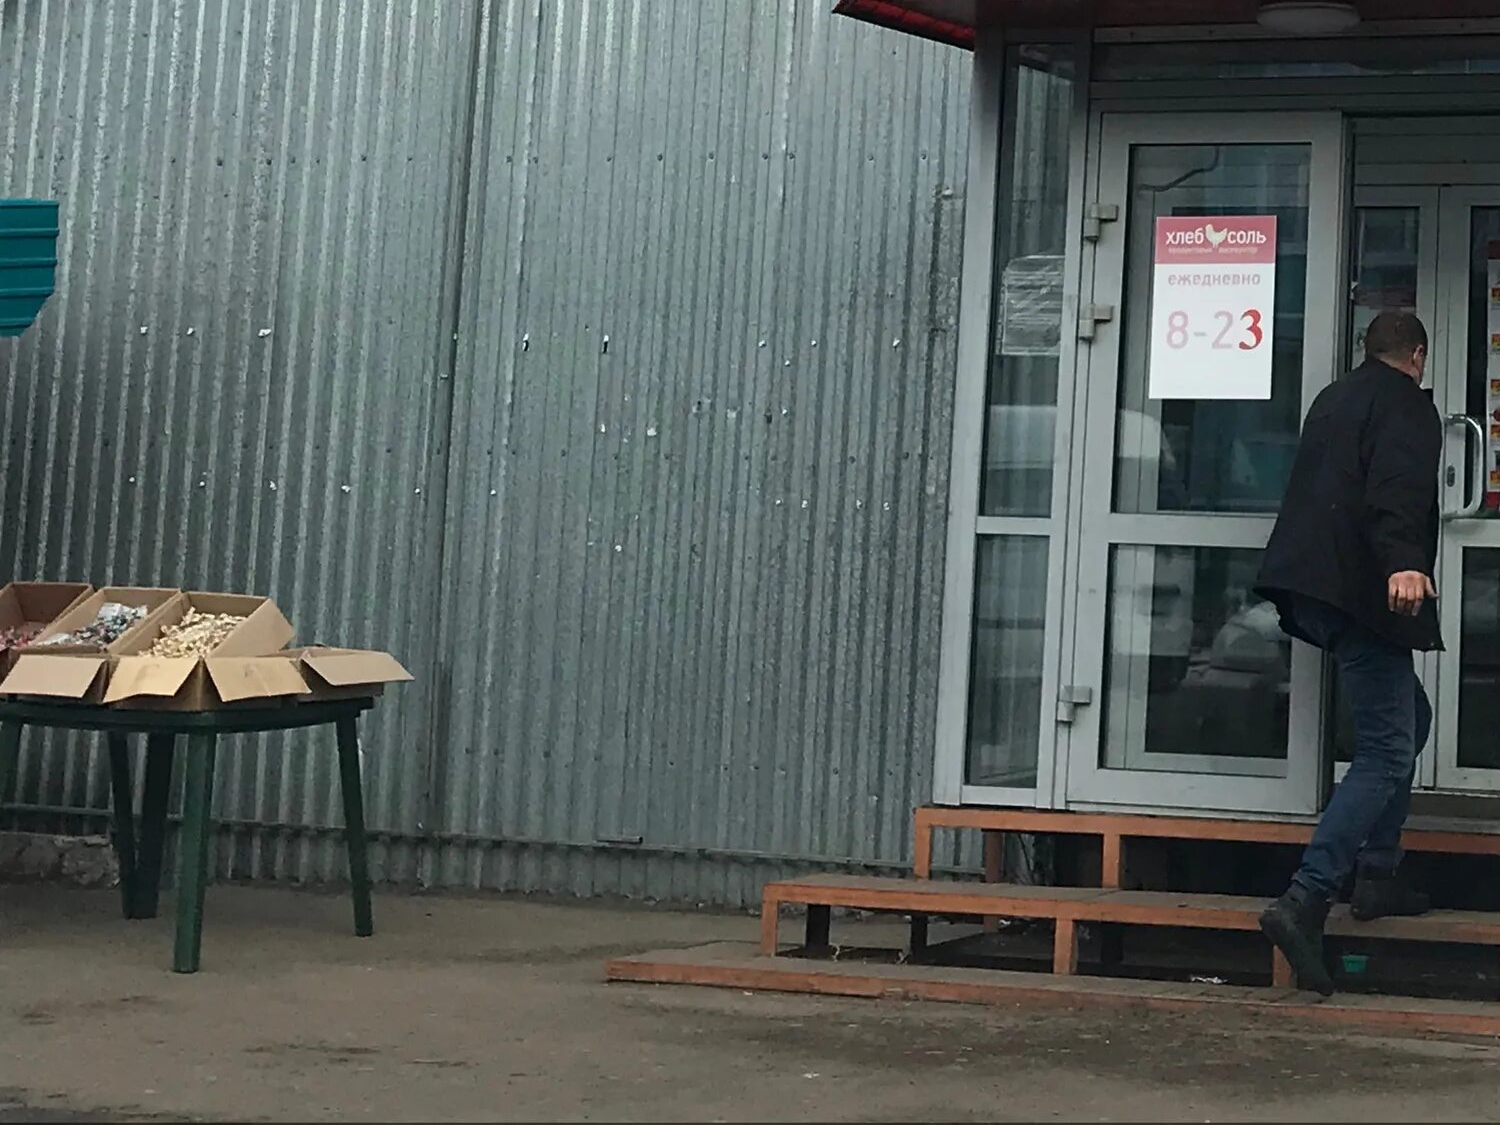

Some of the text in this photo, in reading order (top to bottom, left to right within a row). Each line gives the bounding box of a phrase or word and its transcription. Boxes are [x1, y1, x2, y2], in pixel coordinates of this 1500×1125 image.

[1165, 227, 1267, 245] хлеб соль
[1168, 274, 1261, 287] ежедневно
[1166, 308, 1263, 350] 8-23
